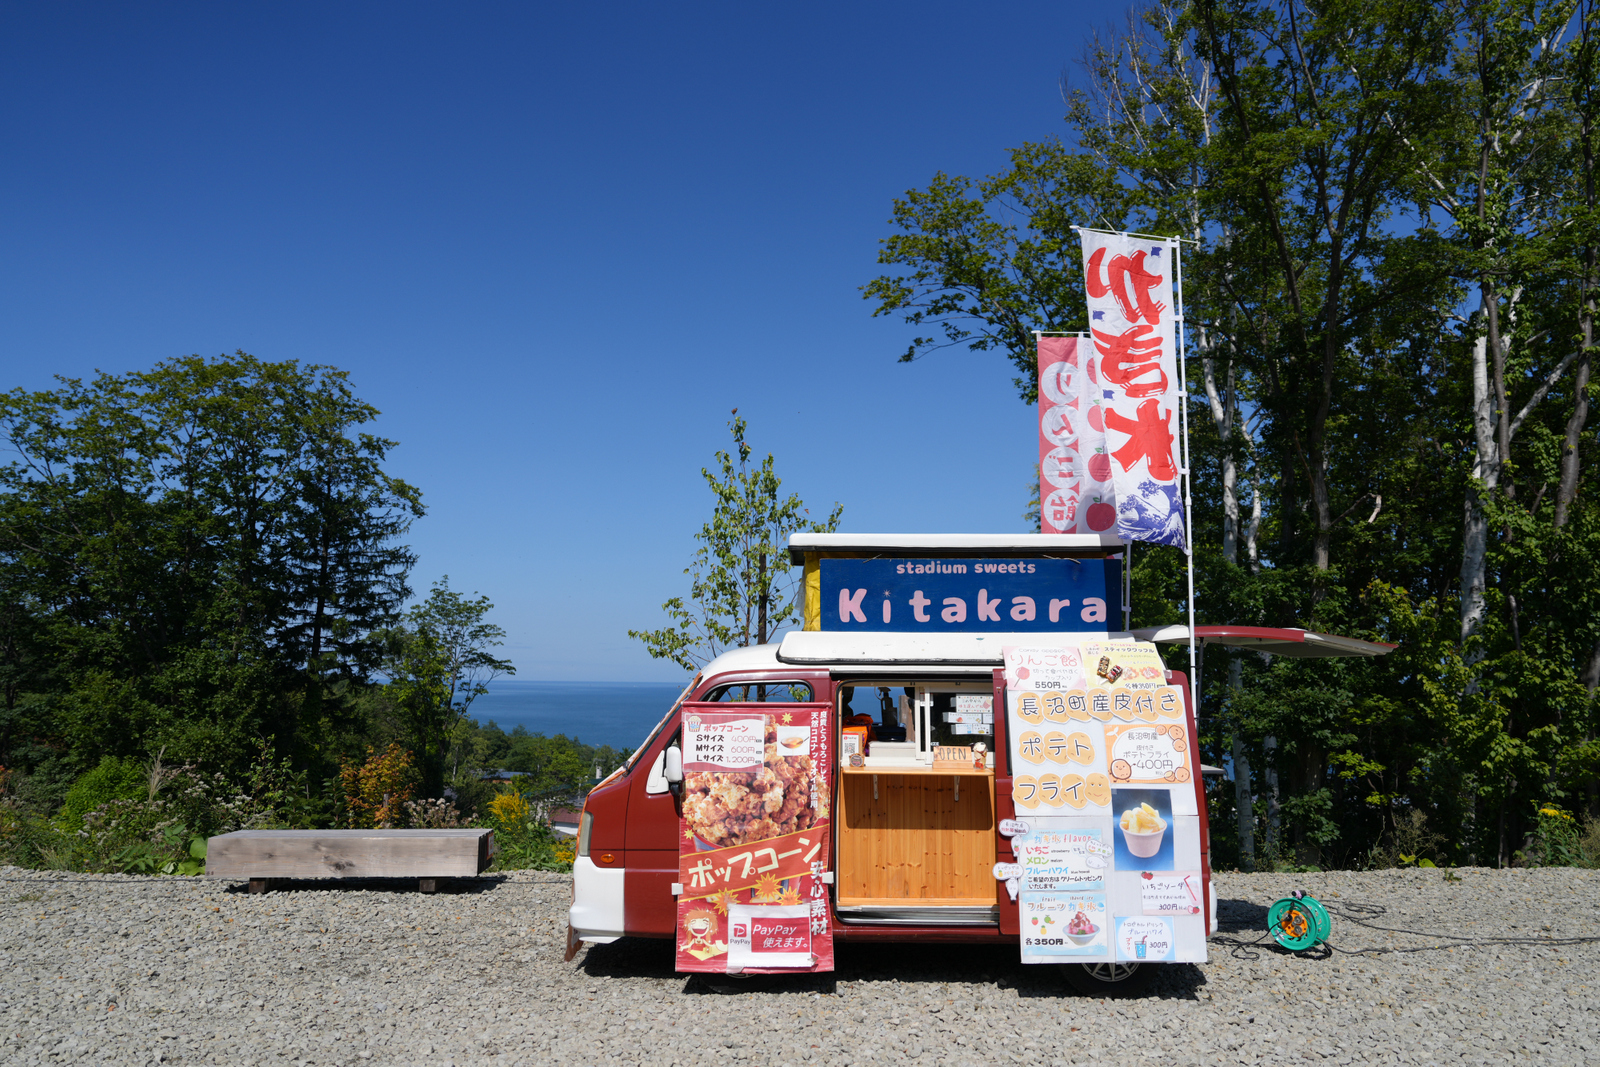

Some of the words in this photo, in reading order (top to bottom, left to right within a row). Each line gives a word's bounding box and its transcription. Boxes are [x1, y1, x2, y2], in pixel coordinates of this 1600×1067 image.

[896, 560, 967, 574] stadium
[974, 560, 1036, 574] sweets
[838, 588, 1107, 624] Kitakara
[1010, 654, 1078, 667] りんご飴
[1022, 693, 1177, 716] 長沼町産皮付き
[1128, 732, 1158, 740] 長沼町産
[820, 711, 828, 783] 良質とうもろこしと
[1022, 737, 1090, 756] ポテト
[939, 748, 967, 760] OPEN
[1137, 760, 1172, 769] 400円
[1019, 781, 1082, 800] フライ
[1034, 835, 1061, 844] カキ氷
[1026, 846, 1050, 854] いちご
[688, 838, 822, 888] ポップコーン
[1026, 857, 1049, 865] メロン
[1026, 866, 1069, 875] ブルーハワイ
[1142, 882, 1184, 890] いちごソーダ
[810, 860, 828, 935] 安心素材
[1028, 903, 1066, 911] フルーツ
[1068, 902, 1096, 912] カキ氷
[752, 925, 797, 935] PayPay
[763, 937, 808, 948] 使えます。
